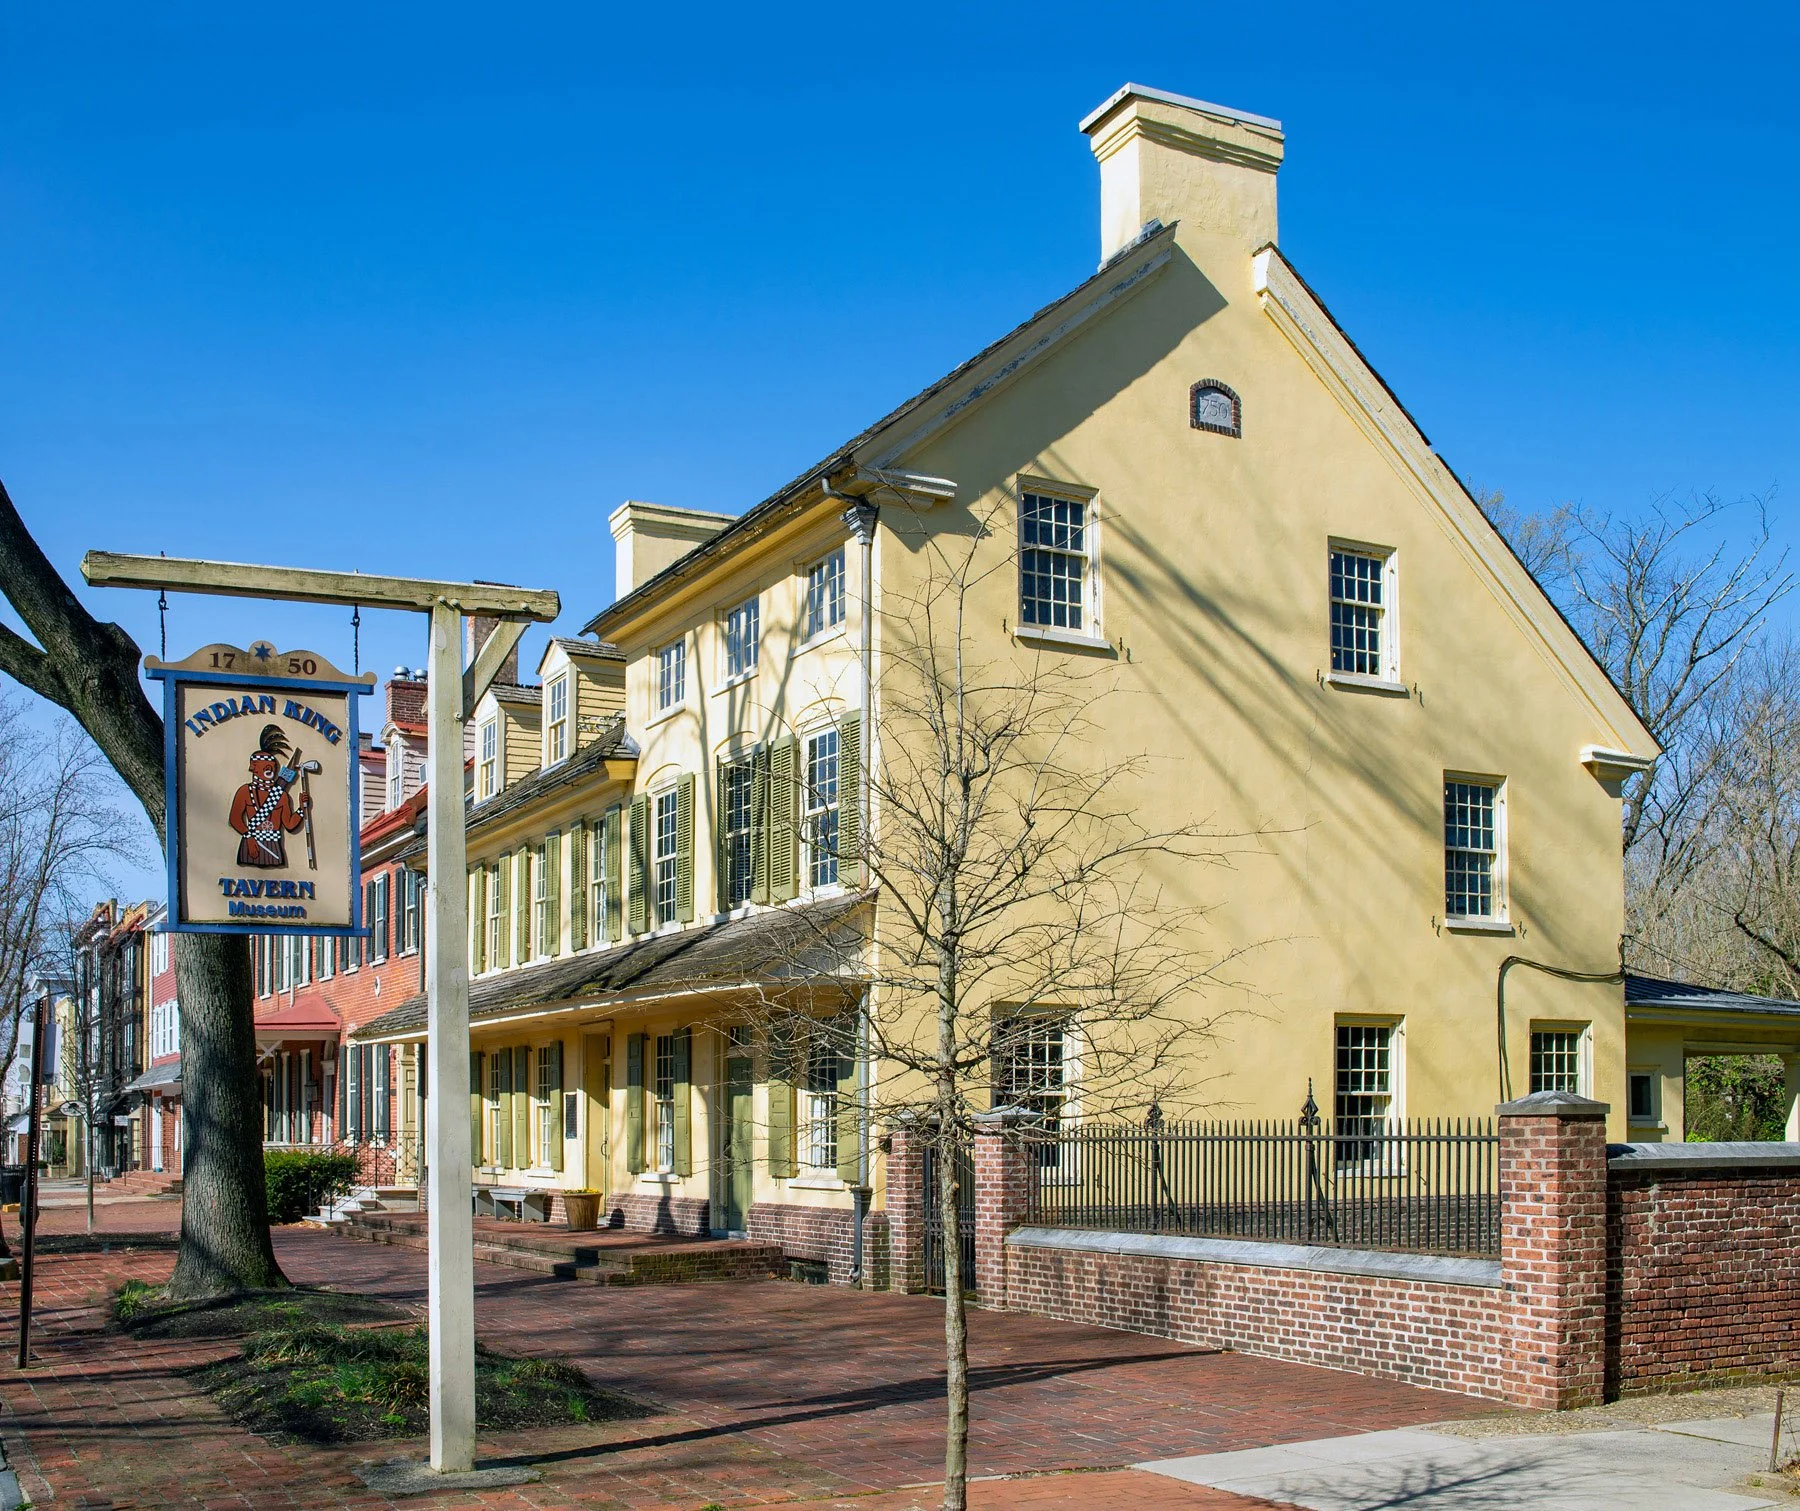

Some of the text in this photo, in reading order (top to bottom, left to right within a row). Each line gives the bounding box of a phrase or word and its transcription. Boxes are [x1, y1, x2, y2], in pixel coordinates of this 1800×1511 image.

[209, 651, 317, 675] 17 50
[185, 694, 343, 745] INDIAN KING
[218, 877, 315, 899] TAVERN
[228, 900, 306, 918] Museum
